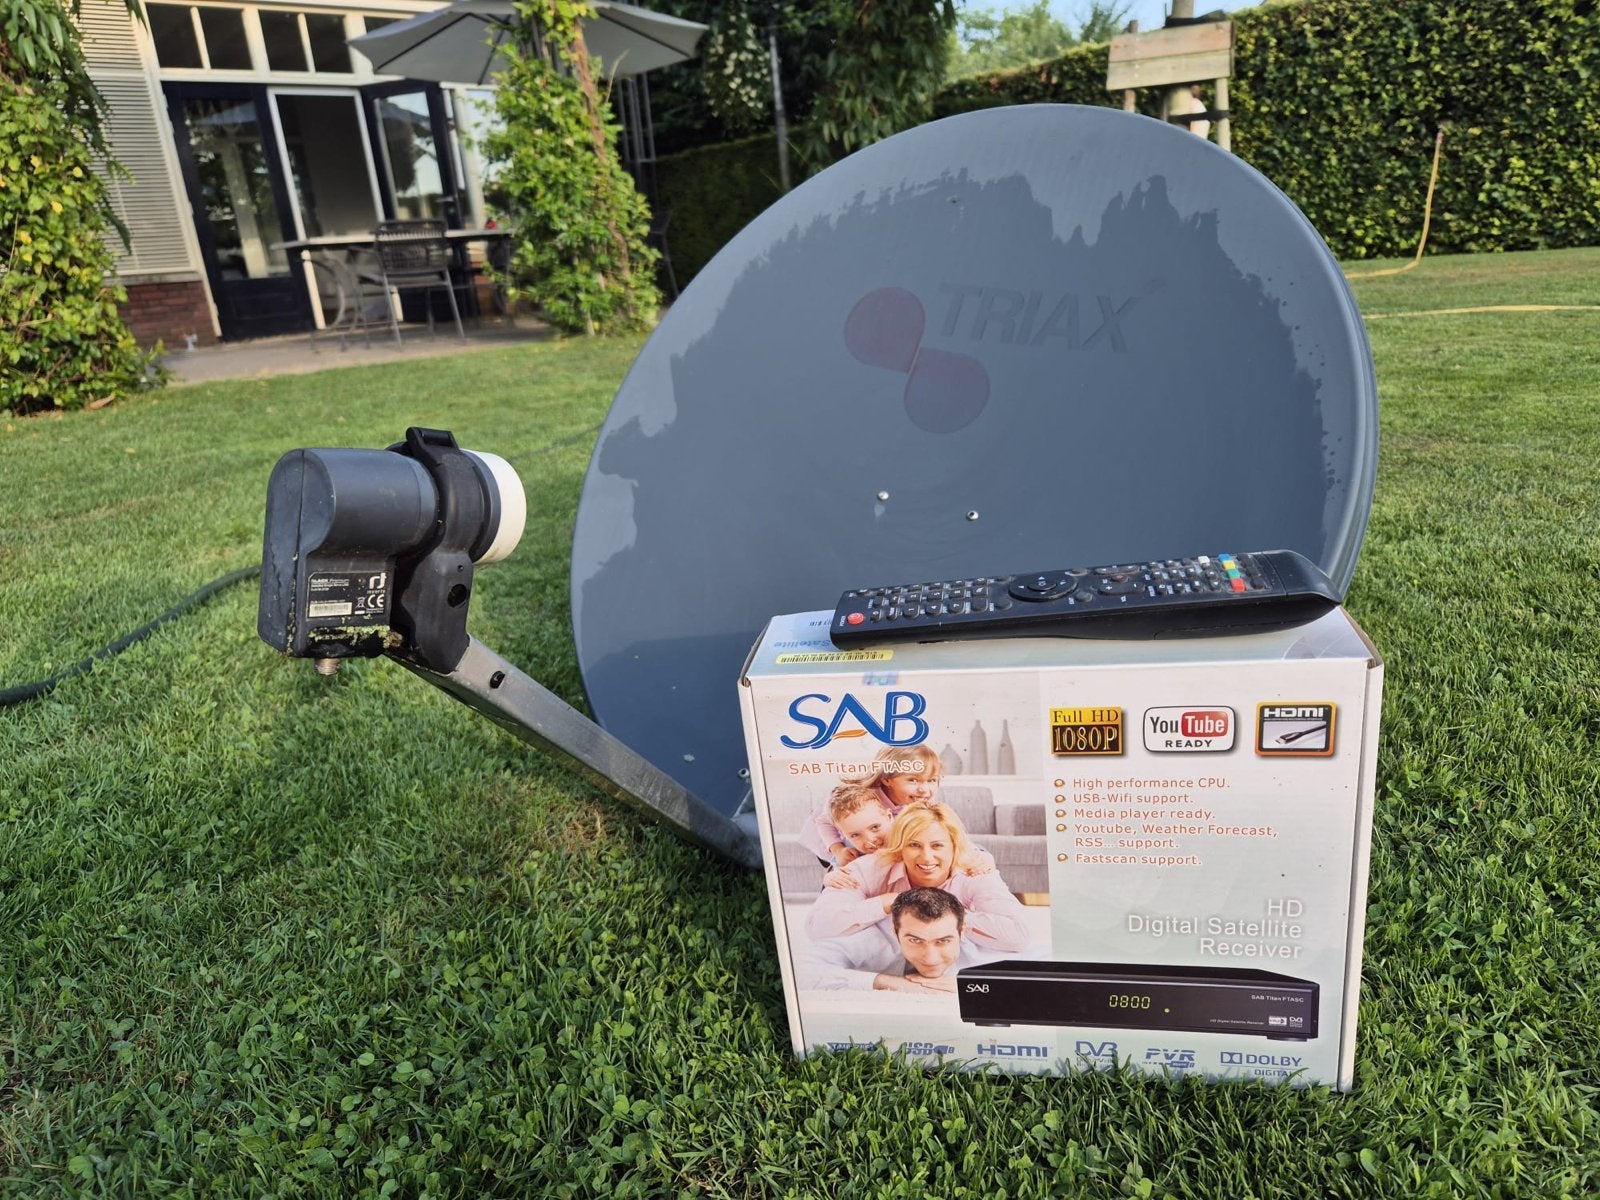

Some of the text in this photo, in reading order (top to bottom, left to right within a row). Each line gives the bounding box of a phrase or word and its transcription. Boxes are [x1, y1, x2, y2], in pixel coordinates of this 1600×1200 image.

[938, 282, 1143, 353] TRIAX
[1053, 709, 1119, 723] Full HD
[1263, 707, 1324, 718] HDMI
[780, 691, 929, 750] SAB
[1150, 715, 1225, 734] YouTube
[1054, 726, 1118, 751] 1080P
[1165, 739, 1213, 748] READY
[789, 760, 926, 775] SAB Titan FTASC
[1073, 778, 1231, 790] High performance CPU.
[1073, 793, 1194, 805] USB-Wifi support.
[1074, 808, 1216, 820] Media player ready.
[1074, 824, 1278, 837] Youtube, Weather Forecast,
[1118, 839, 1179, 849] support.
[1076, 853, 1202, 866] Fastscan support.
[1268, 899, 1303, 917] HD
[1128, 914, 1302, 938] Digital Satellite
[1200, 938, 1302, 959] Receiver
[965, 983, 990, 993] SAB
[1109, 994, 1151, 1009] 0800
[977, 1043, 1048, 1058] HDMI
[1076, 1040, 1118, 1057] DVB
[1145, 1048, 1196, 1061] PVR
[1246, 1054, 1302, 1067] DOLBY
